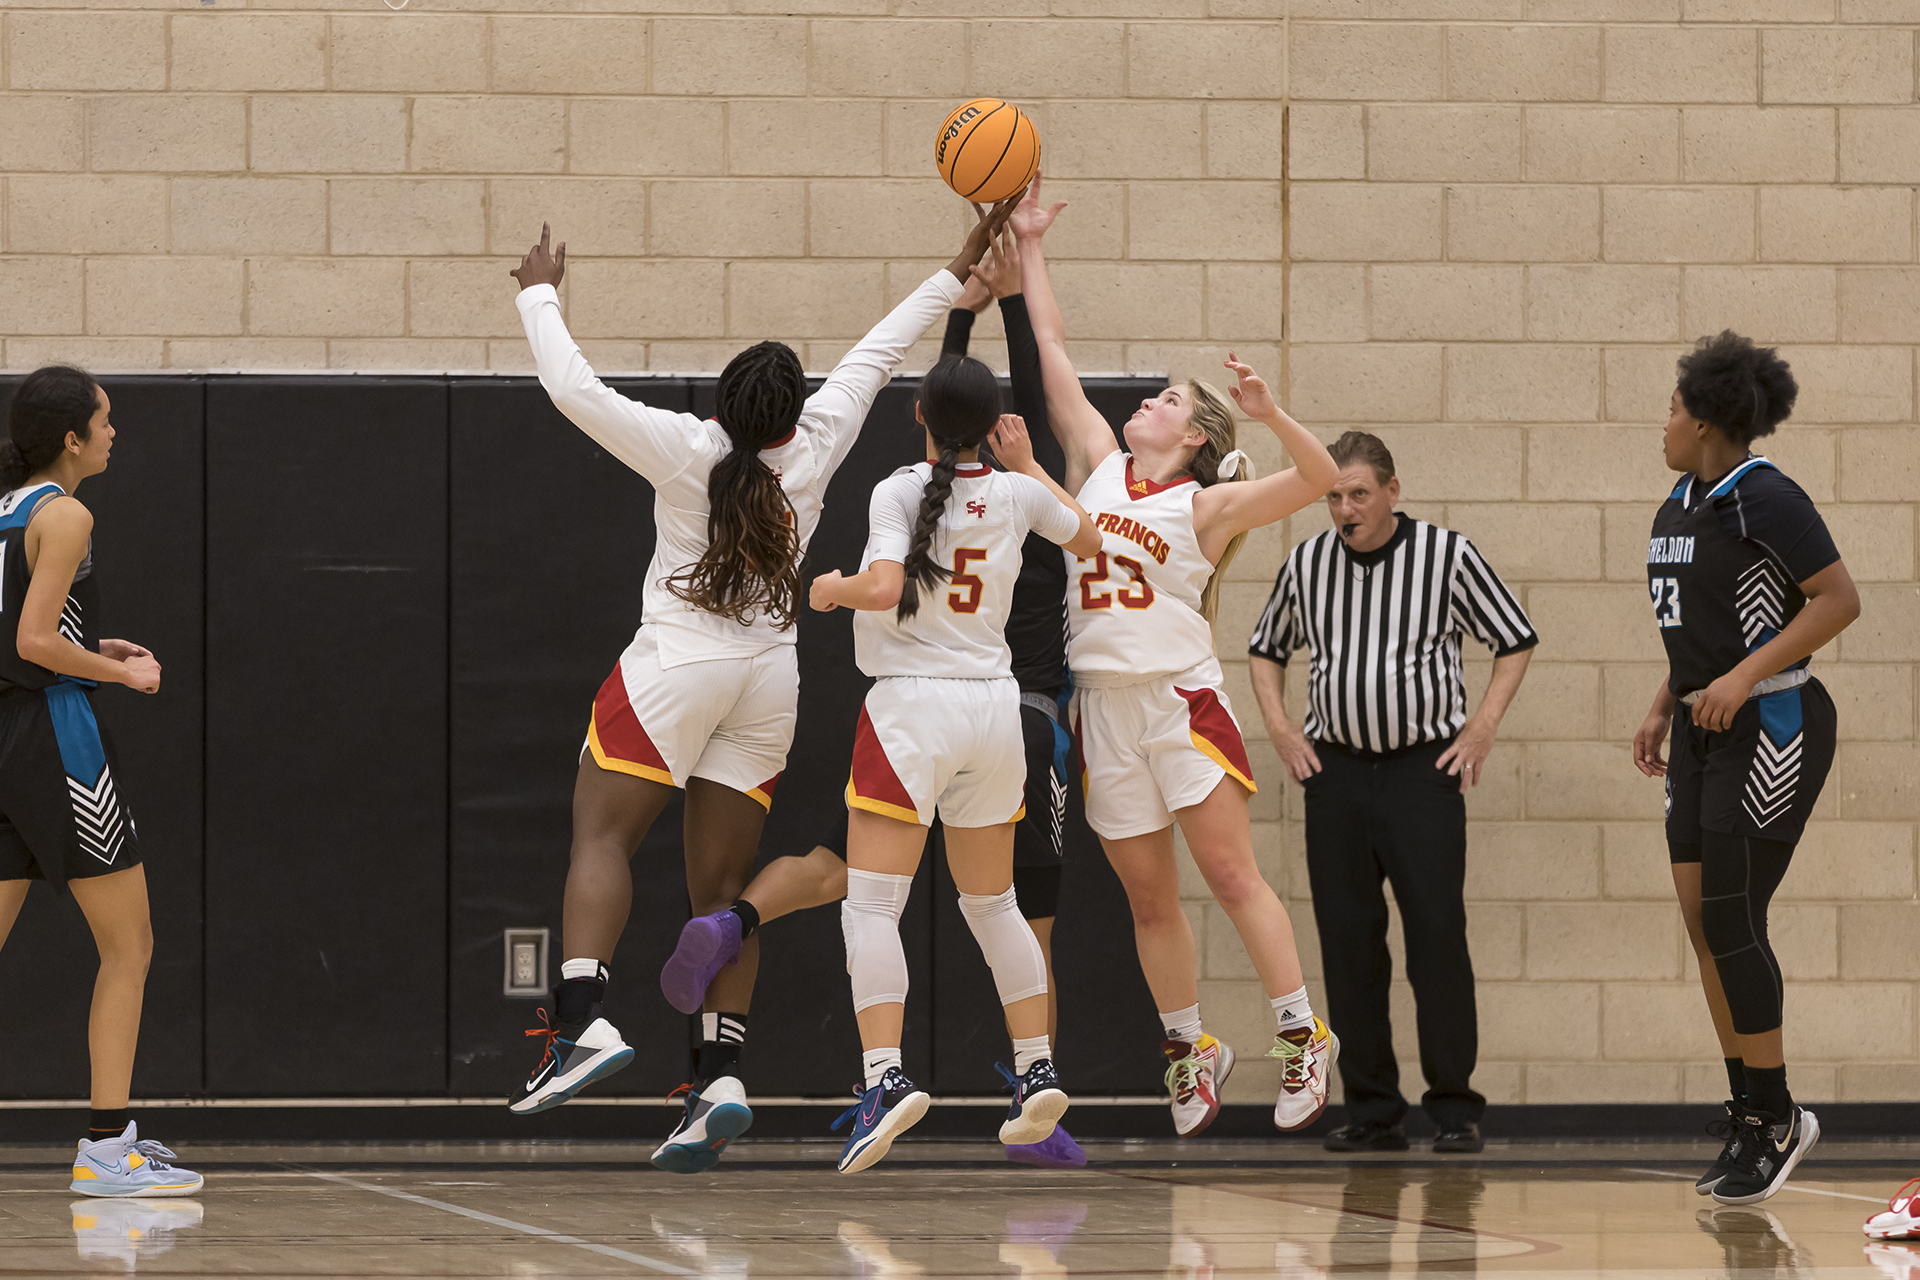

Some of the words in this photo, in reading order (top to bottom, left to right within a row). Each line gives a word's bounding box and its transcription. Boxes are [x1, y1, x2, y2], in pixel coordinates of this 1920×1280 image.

[938, 107, 982, 164] Wilson
[965, 500, 987, 520] SF
[1095, 512, 1171, 565] FRANCIS
[947, 547, 988, 614] 5
[1077, 551, 1155, 610] 23
[1651, 577, 1683, 628] 23
